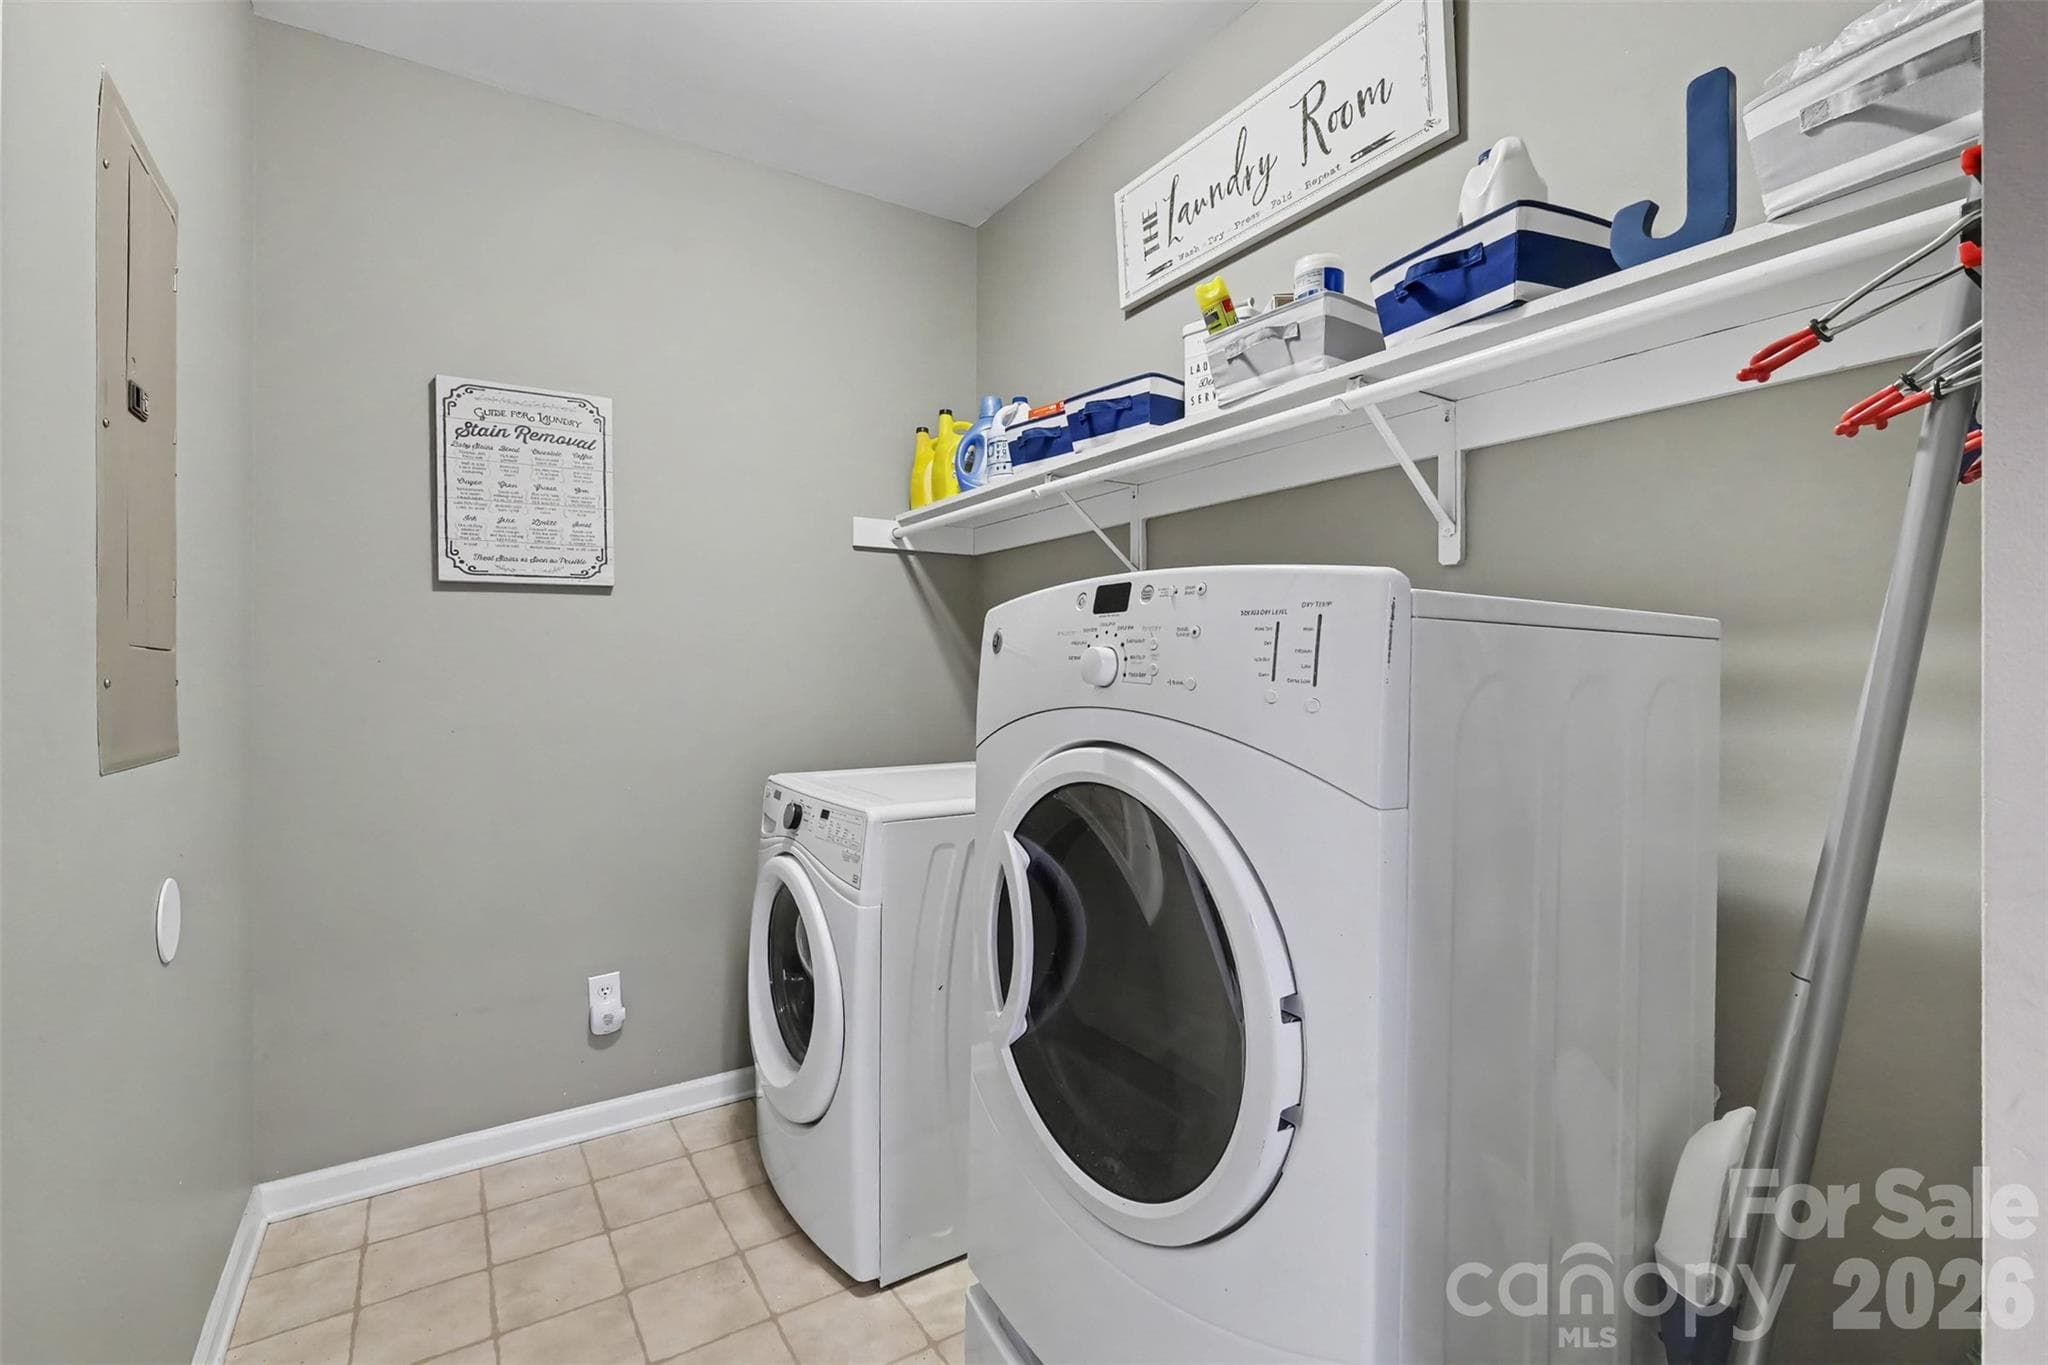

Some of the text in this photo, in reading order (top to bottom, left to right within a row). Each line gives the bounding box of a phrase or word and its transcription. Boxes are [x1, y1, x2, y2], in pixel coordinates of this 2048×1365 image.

[1163, 78, 1394, 248] Laundry Room
[1142, 201, 1160, 261] THE
[1178, 163, 1343, 260] Wash Dry Press Fold Repeat
[455, 421, 597, 451] Stain Removal
